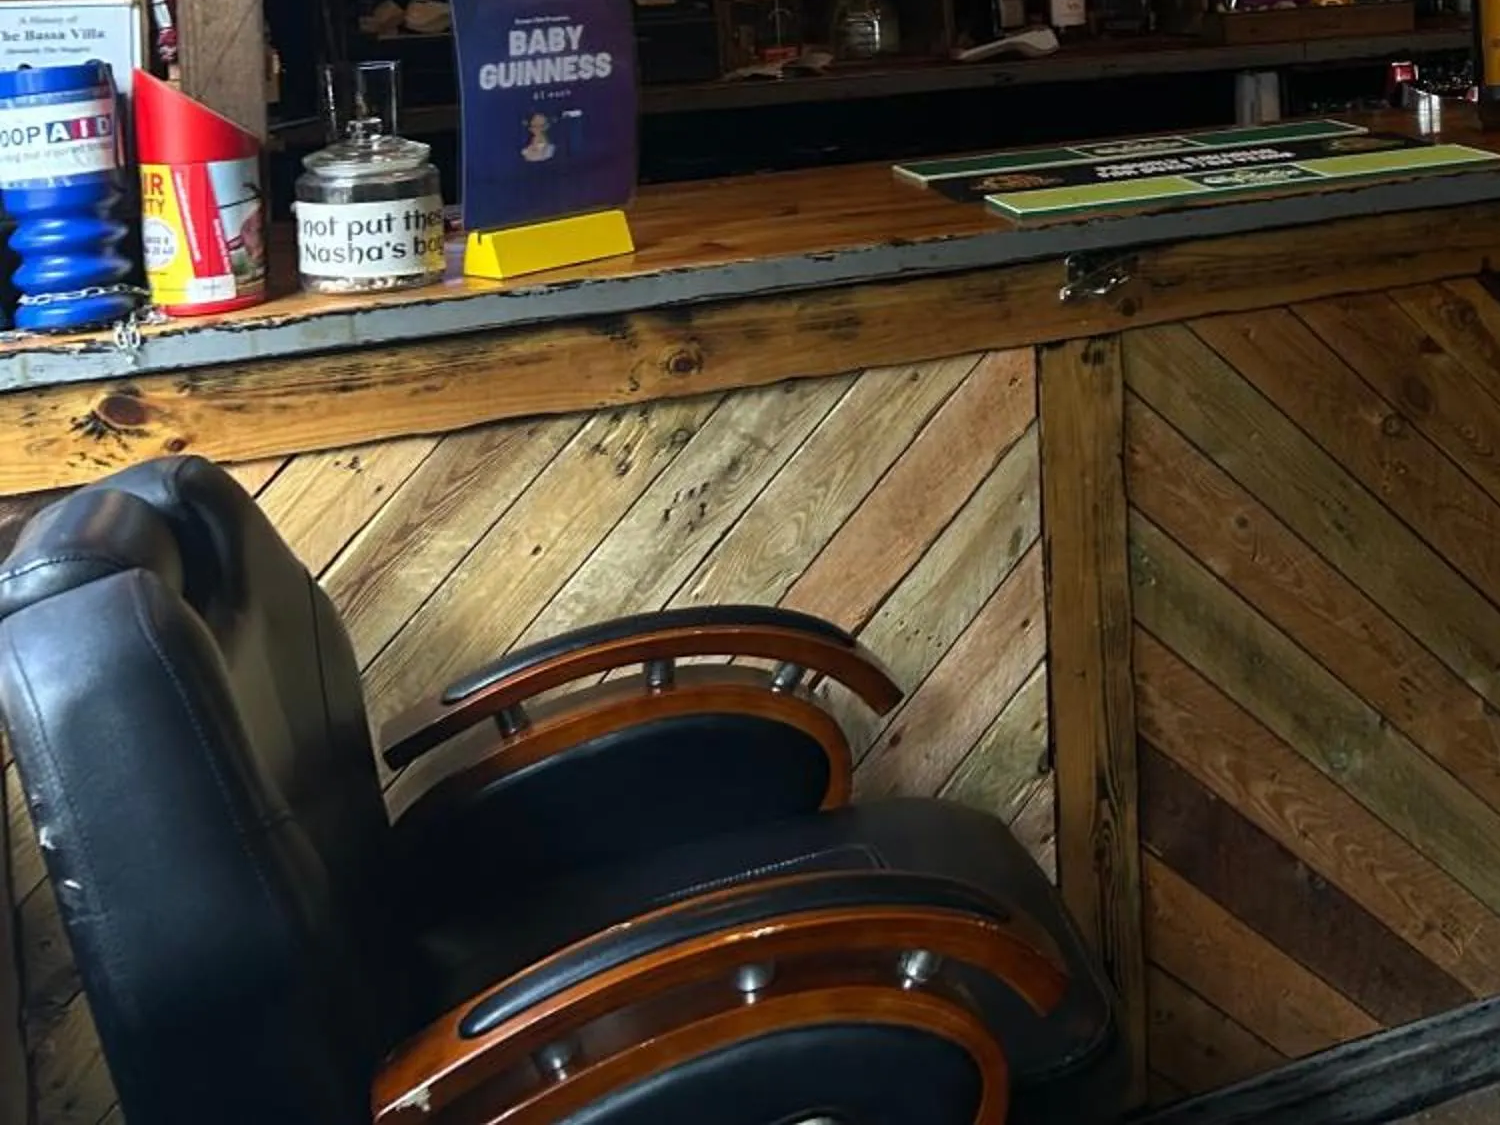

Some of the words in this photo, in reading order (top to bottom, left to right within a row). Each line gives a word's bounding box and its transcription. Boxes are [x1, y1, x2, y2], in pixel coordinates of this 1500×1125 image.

[25, 29, 67, 41] Bassa
[69, 27, 106, 40] Villa
[508, 24, 585, 58] BABY
[478, 51, 613, 91] GUINNESS
[50, 115, 111, 143] AID
[303, 216, 339, 238] not
[346, 211, 397, 241] put
[304, 240, 407, 265] Nasha's
